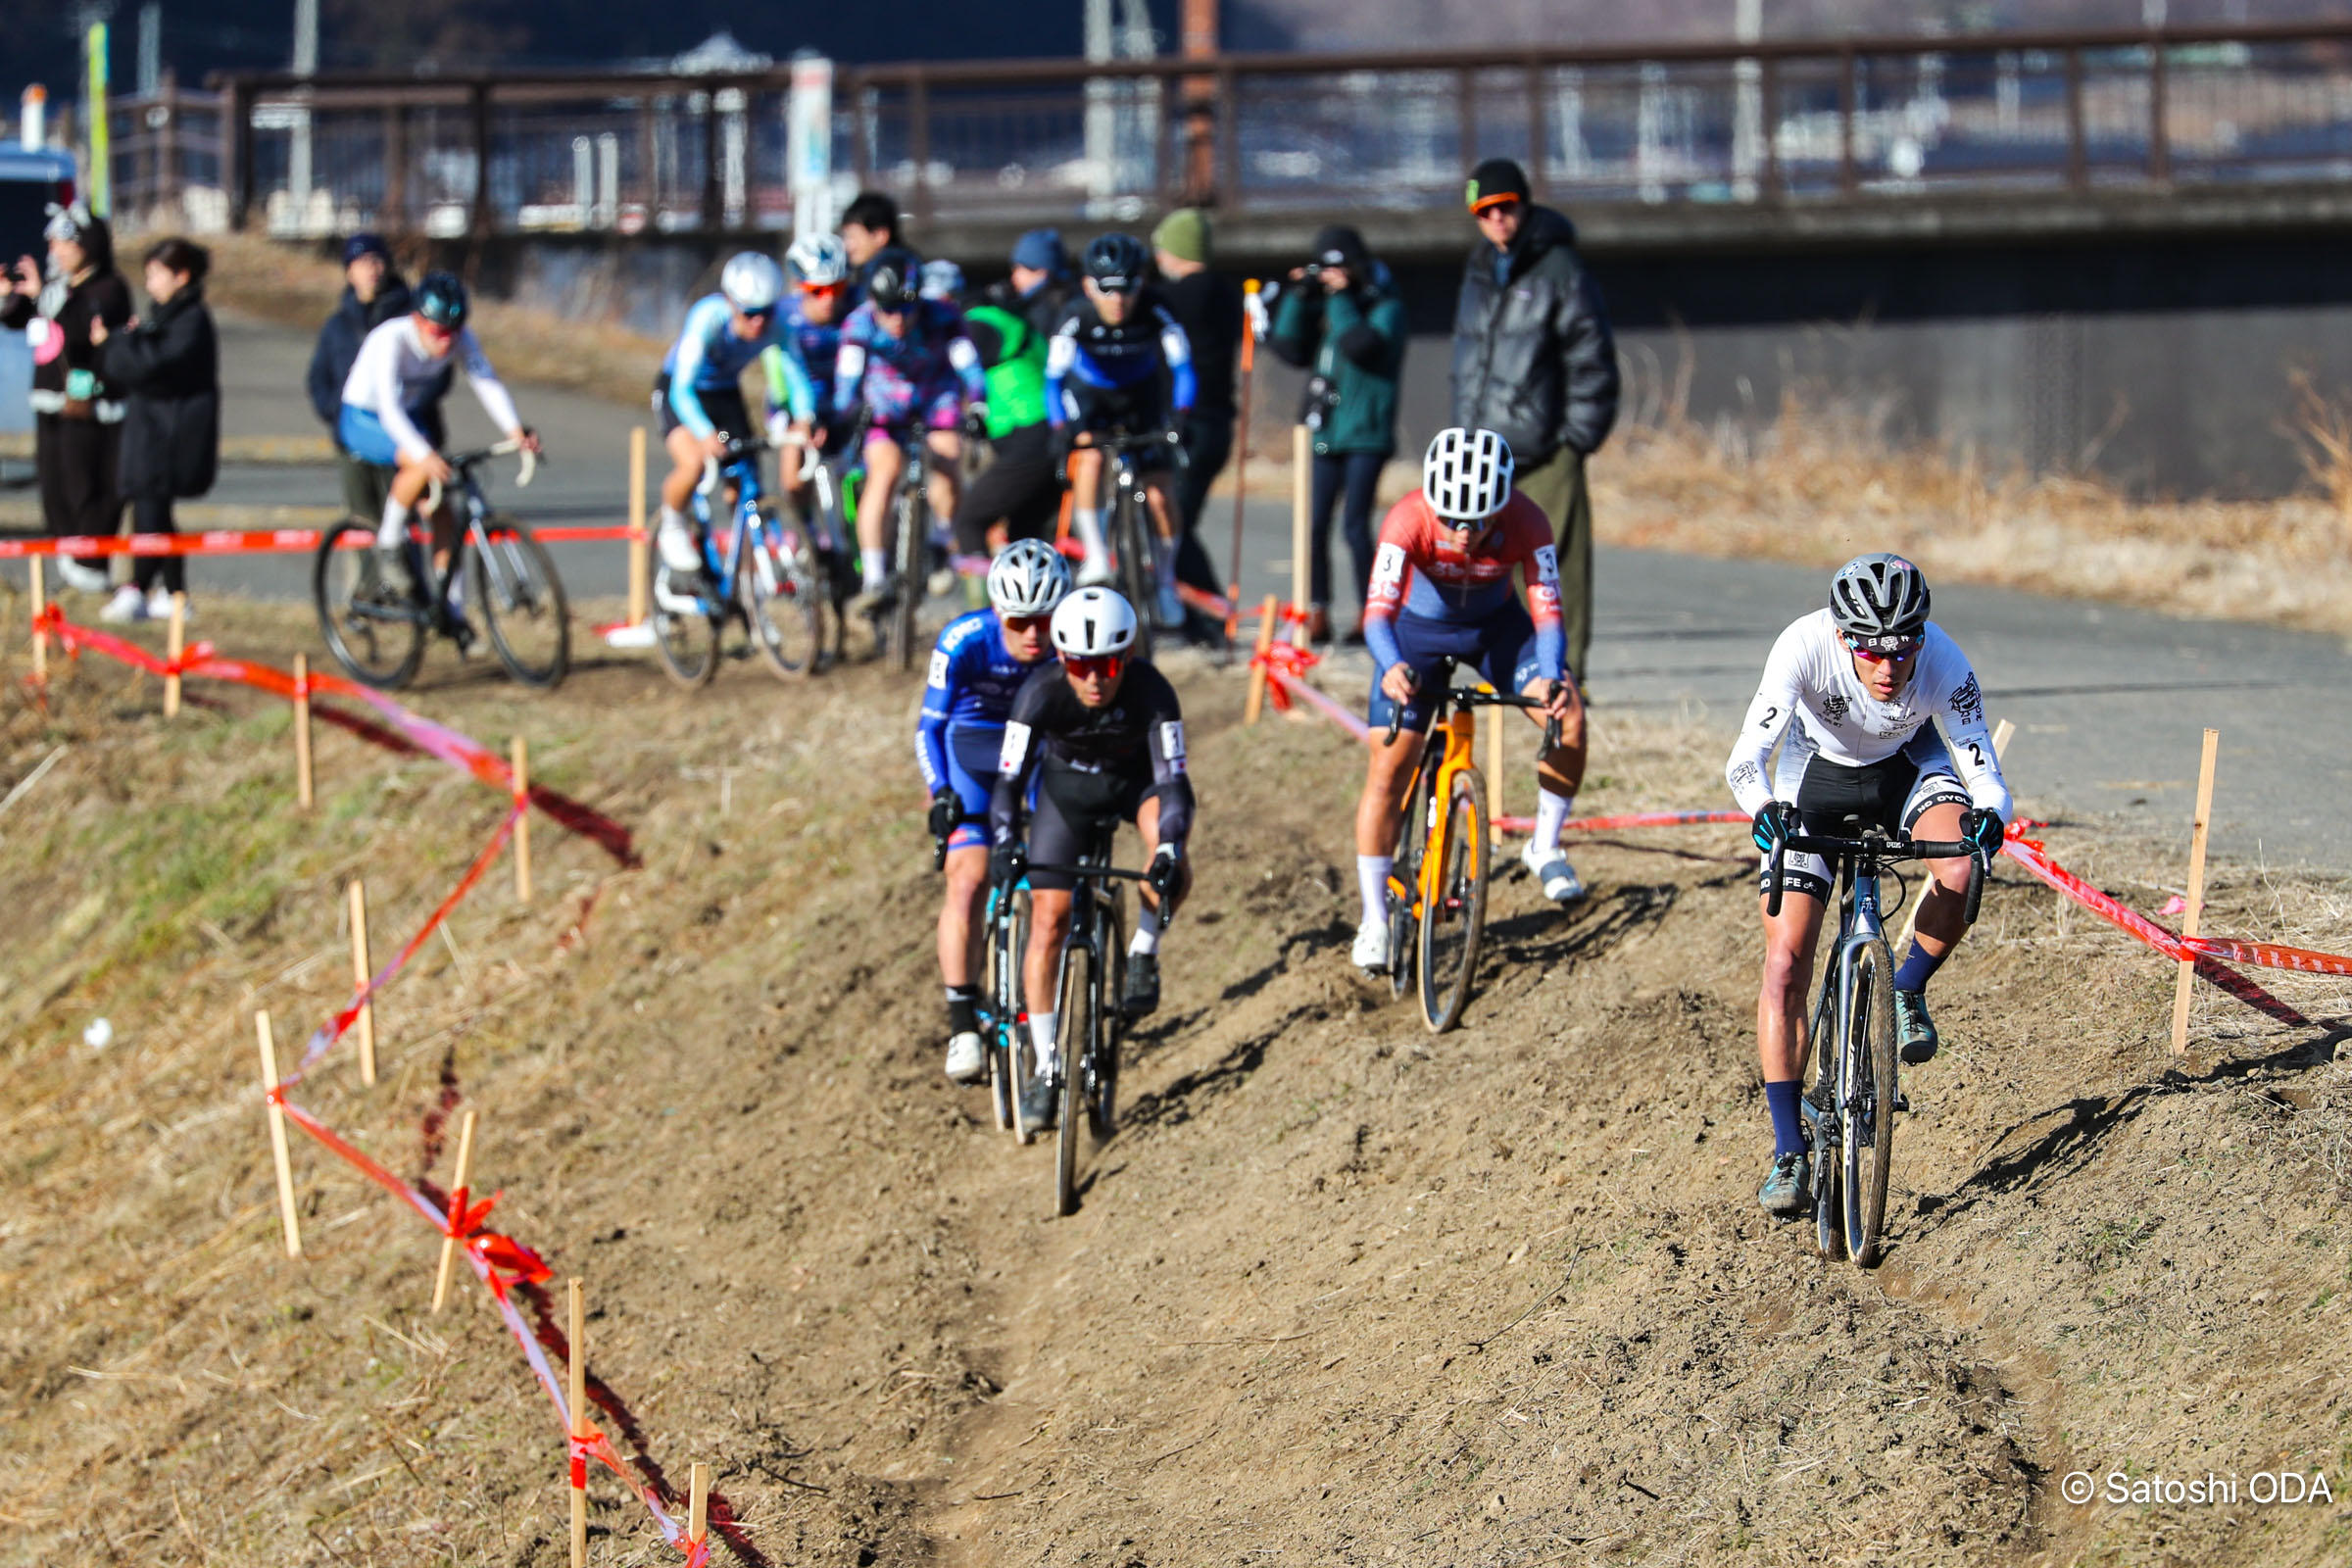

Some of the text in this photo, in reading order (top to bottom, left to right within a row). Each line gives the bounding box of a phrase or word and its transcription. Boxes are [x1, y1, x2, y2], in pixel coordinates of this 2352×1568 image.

[1383, 554, 1393, 572] 3
[1759, 707, 1778, 729] 2
[1969, 743, 1985, 766] 2
[1917, 800, 1934, 813] NO
[1783, 877, 1801, 888] IFE
